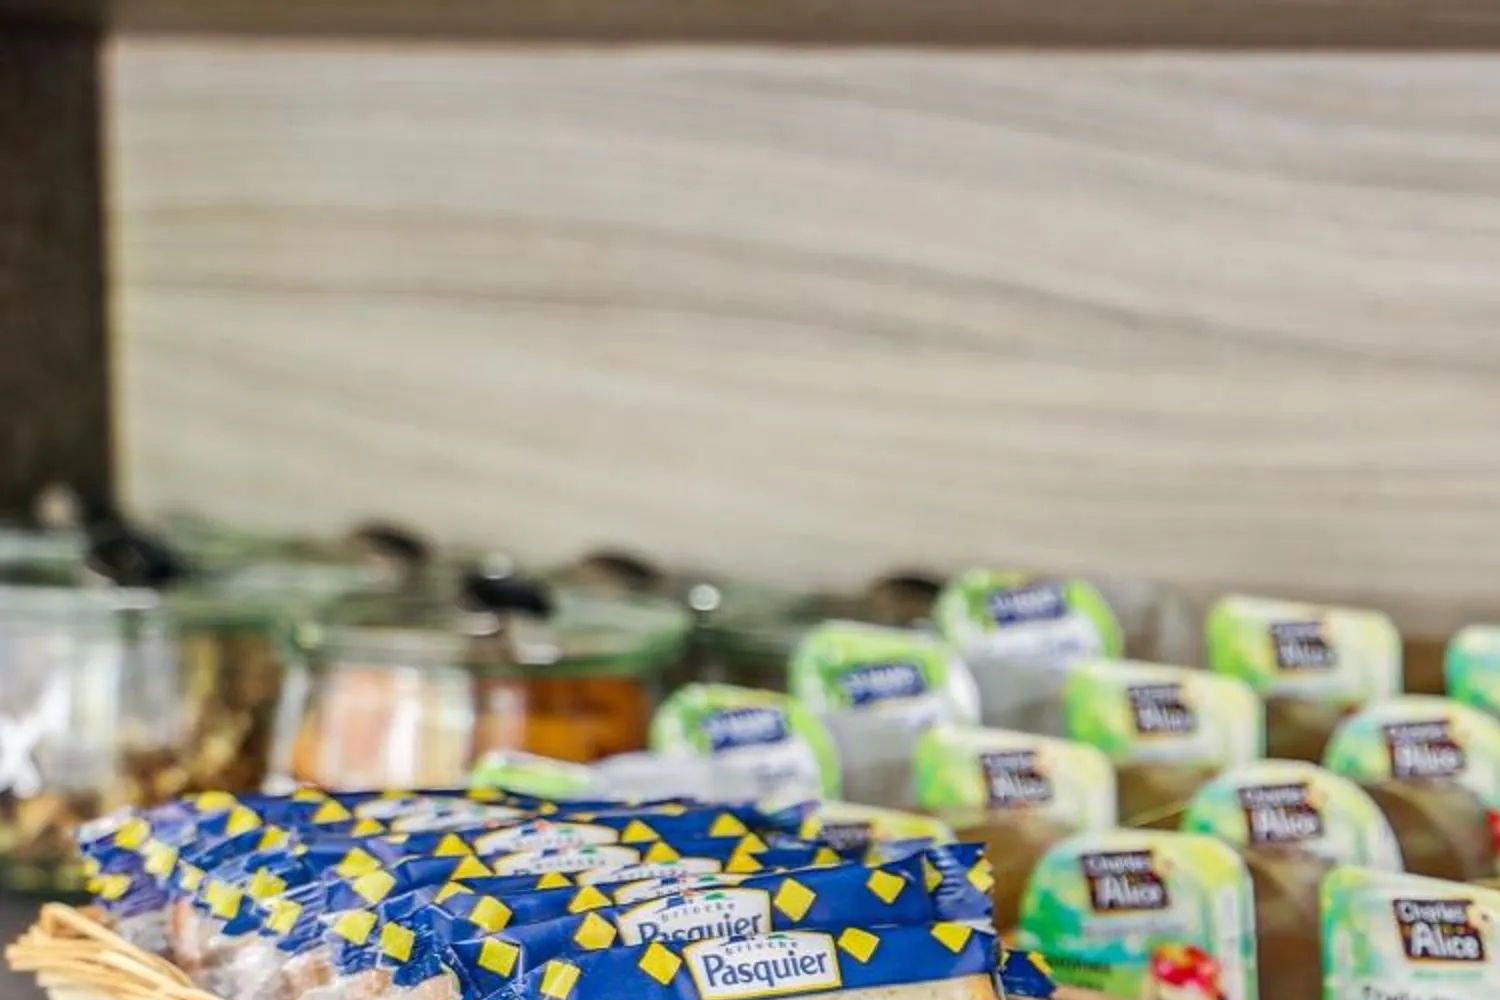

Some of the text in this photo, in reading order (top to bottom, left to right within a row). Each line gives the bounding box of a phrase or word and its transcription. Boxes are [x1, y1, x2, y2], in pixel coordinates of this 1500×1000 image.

[1099, 874, 1166, 908] Alice
[1410, 921, 1482, 960] Alice
[701, 950, 828, 988] Pasquier
